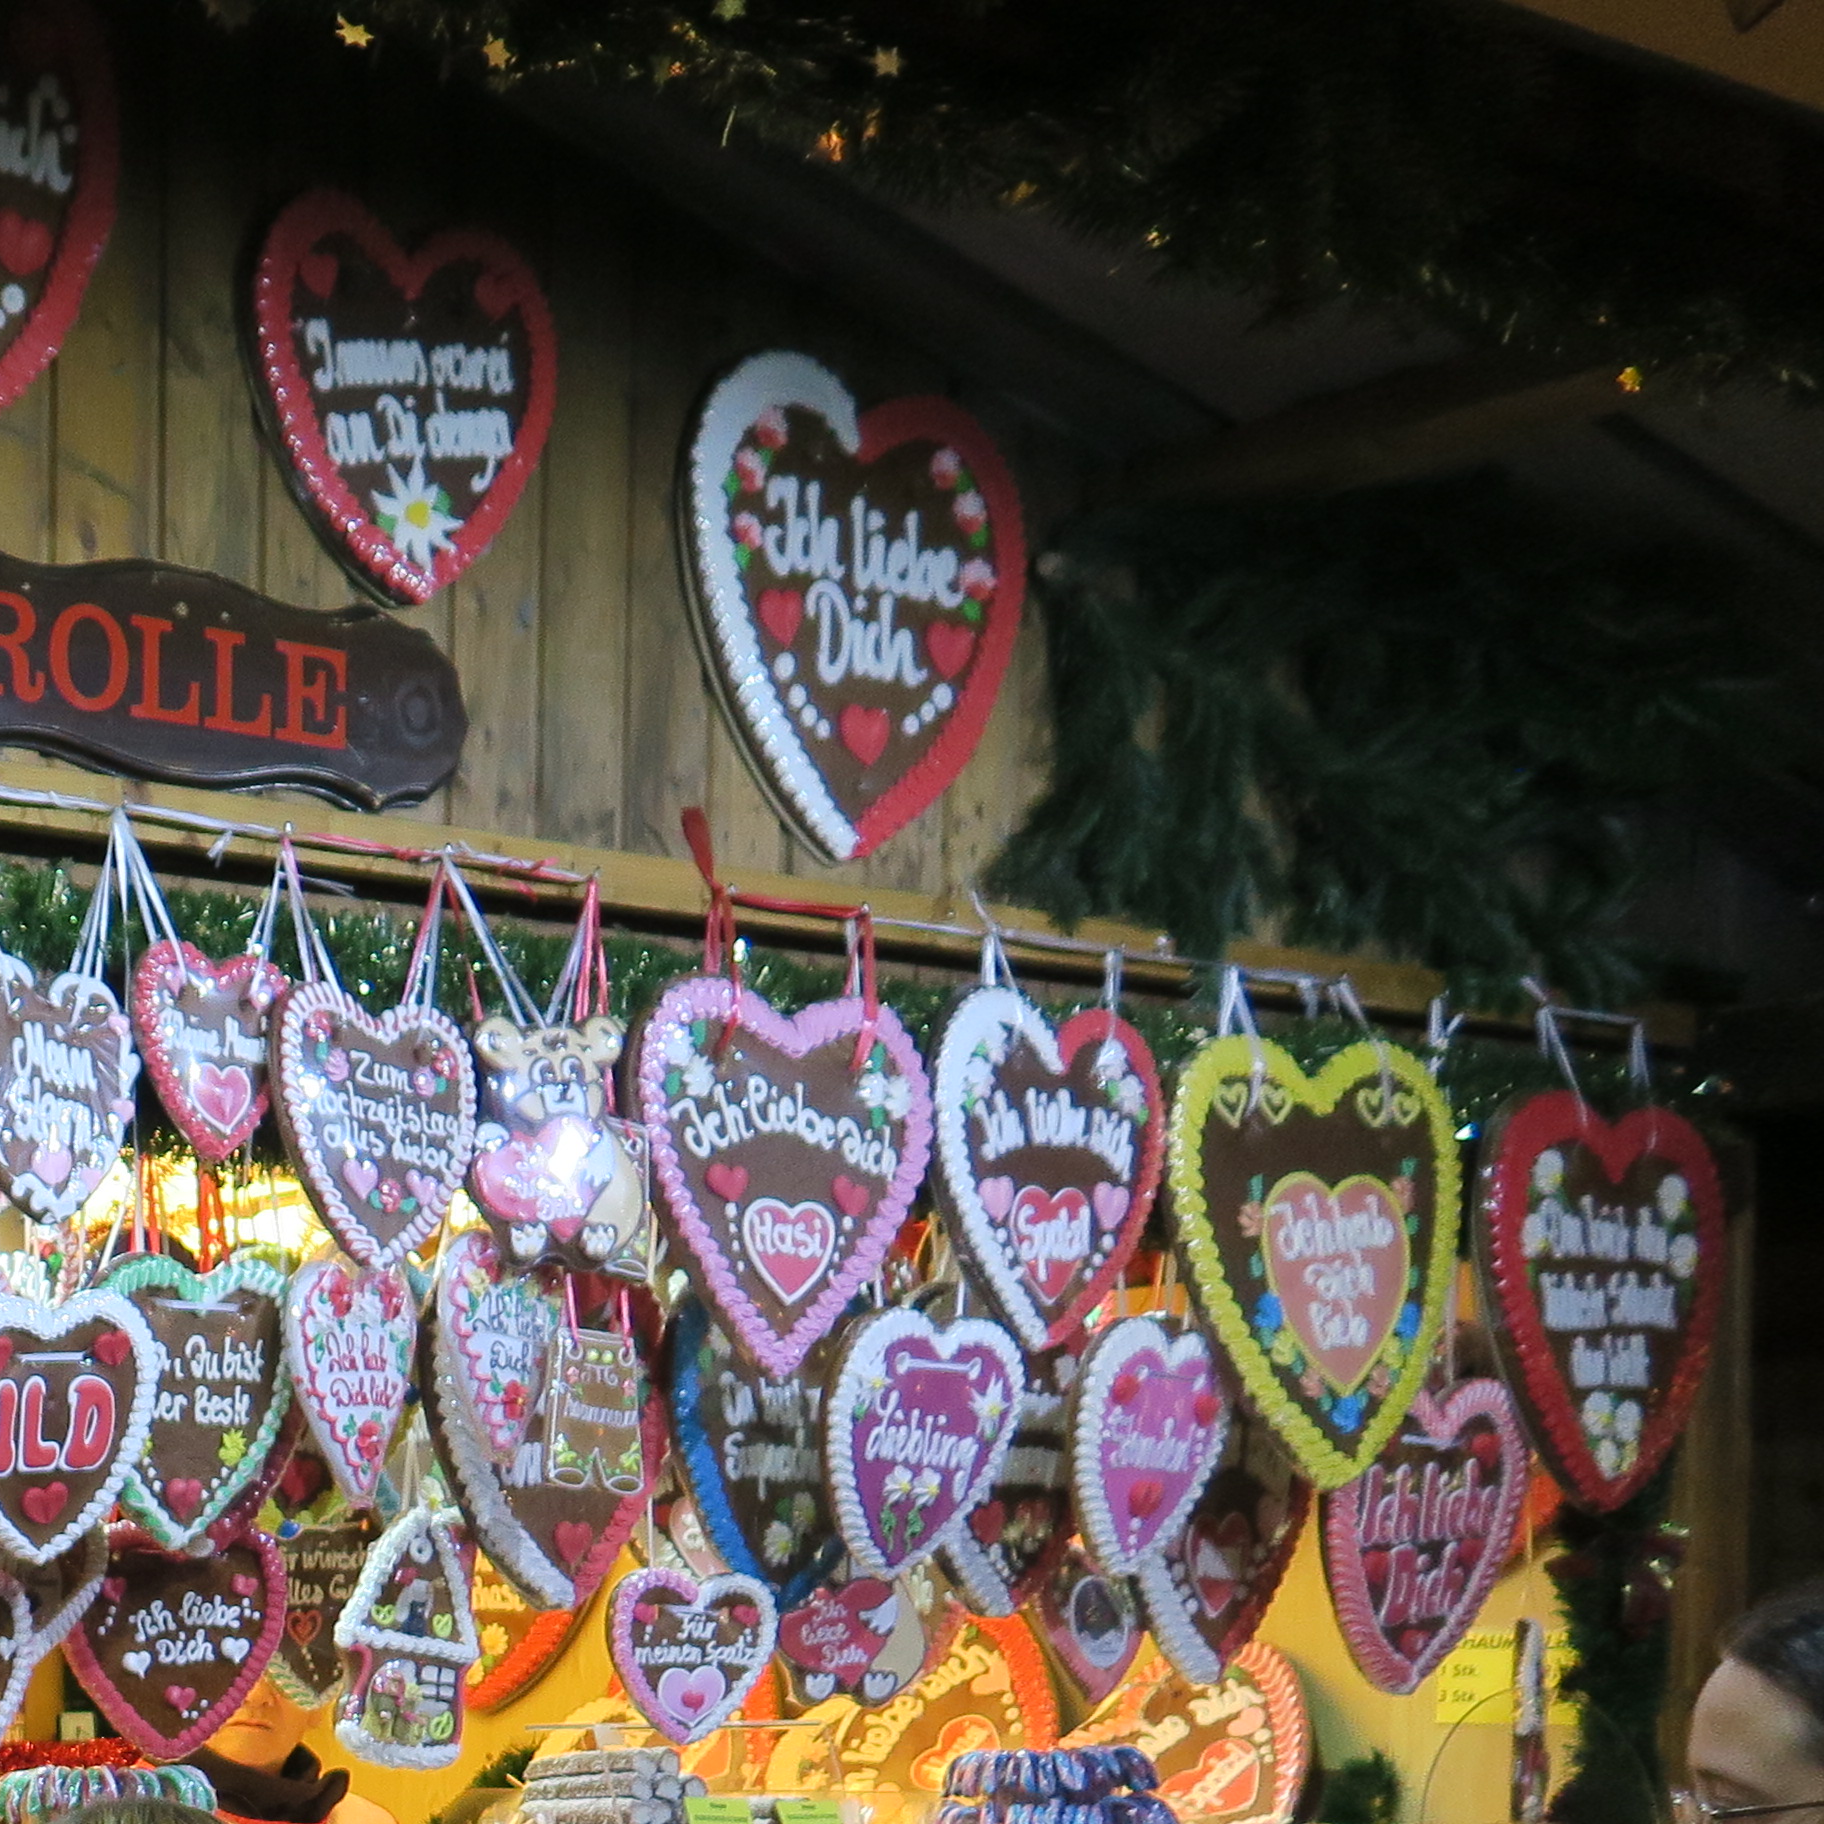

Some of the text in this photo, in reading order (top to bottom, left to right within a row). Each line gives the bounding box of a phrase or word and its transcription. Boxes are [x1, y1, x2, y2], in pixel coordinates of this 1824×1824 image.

[763, 474, 846, 582] Ich
[806, 578, 928, 688] Dich
[349, 1050, 414, 1093] Zum
[669, 1083, 755, 1158] Ich
[751, 1212, 824, 1259] Hasi
[865, 1390, 980, 1503] Liebling
[155, 1629, 215, 1664] Dich
[678, 1612, 717, 1639] Für
